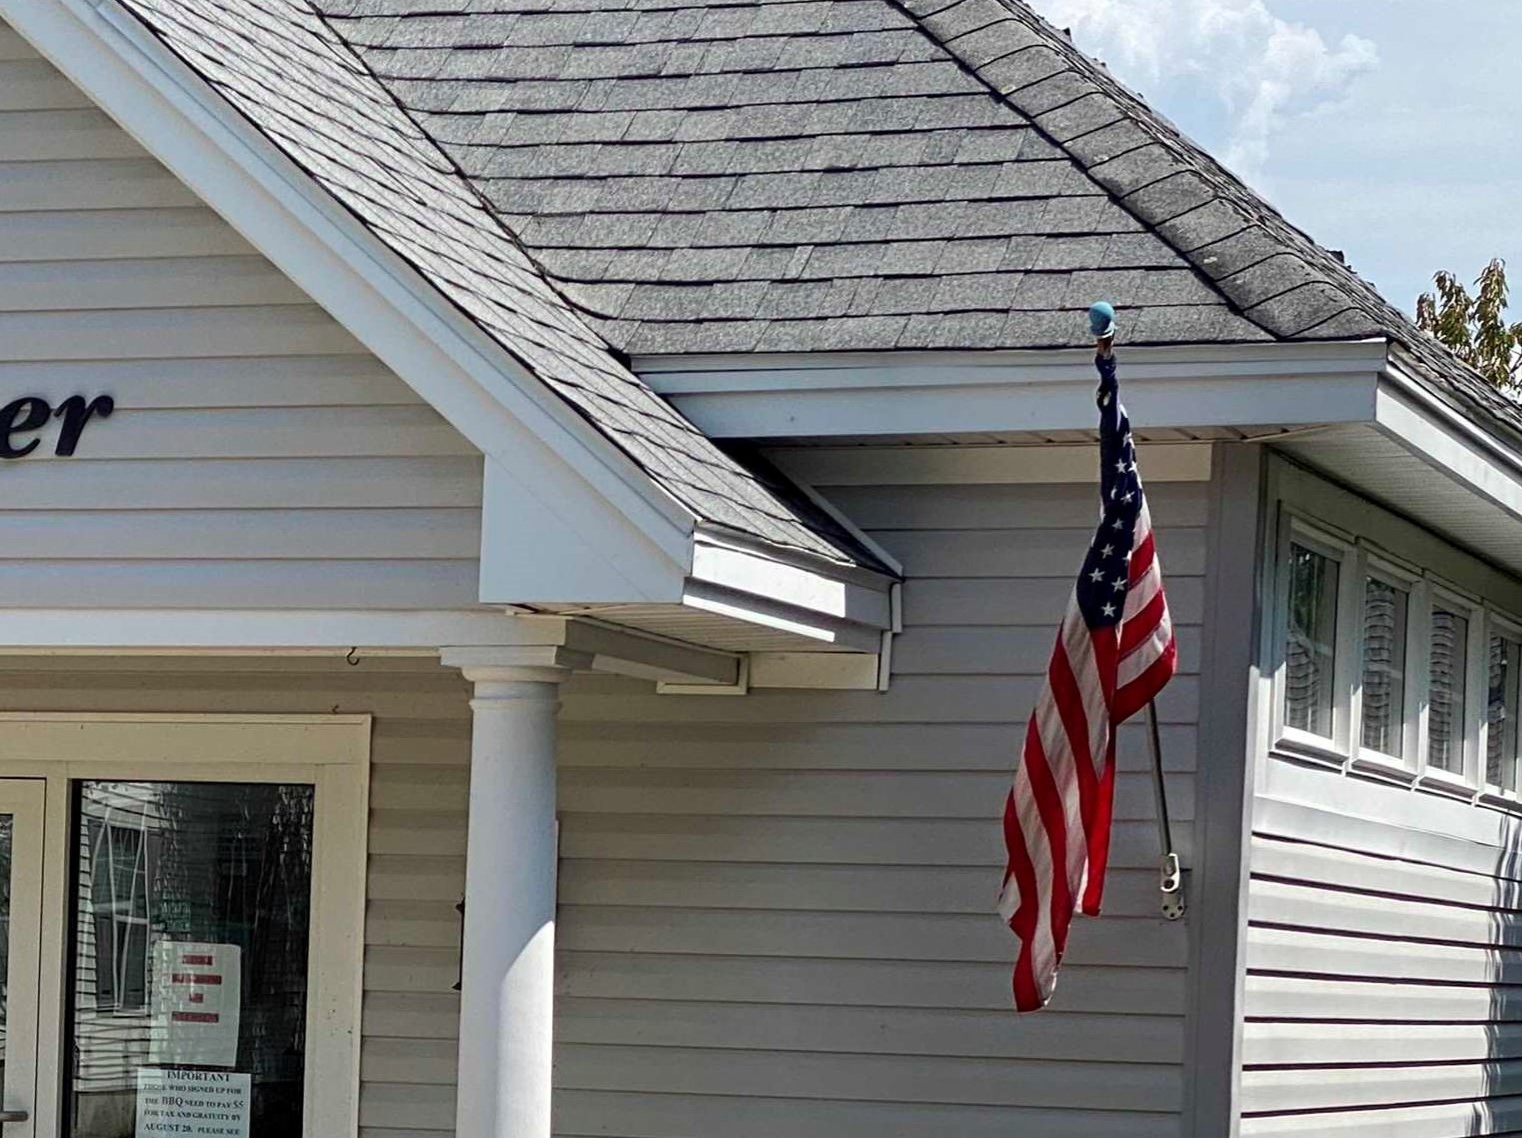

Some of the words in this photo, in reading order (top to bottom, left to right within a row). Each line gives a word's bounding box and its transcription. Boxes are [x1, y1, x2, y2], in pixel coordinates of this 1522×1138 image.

[167, 1071, 230, 1082] IMPORTANT
[162, 1096, 184, 1108] BBQ
[160, 1110, 176, 1118] TAX
[144, 1123, 180, 1132] AUGUST
